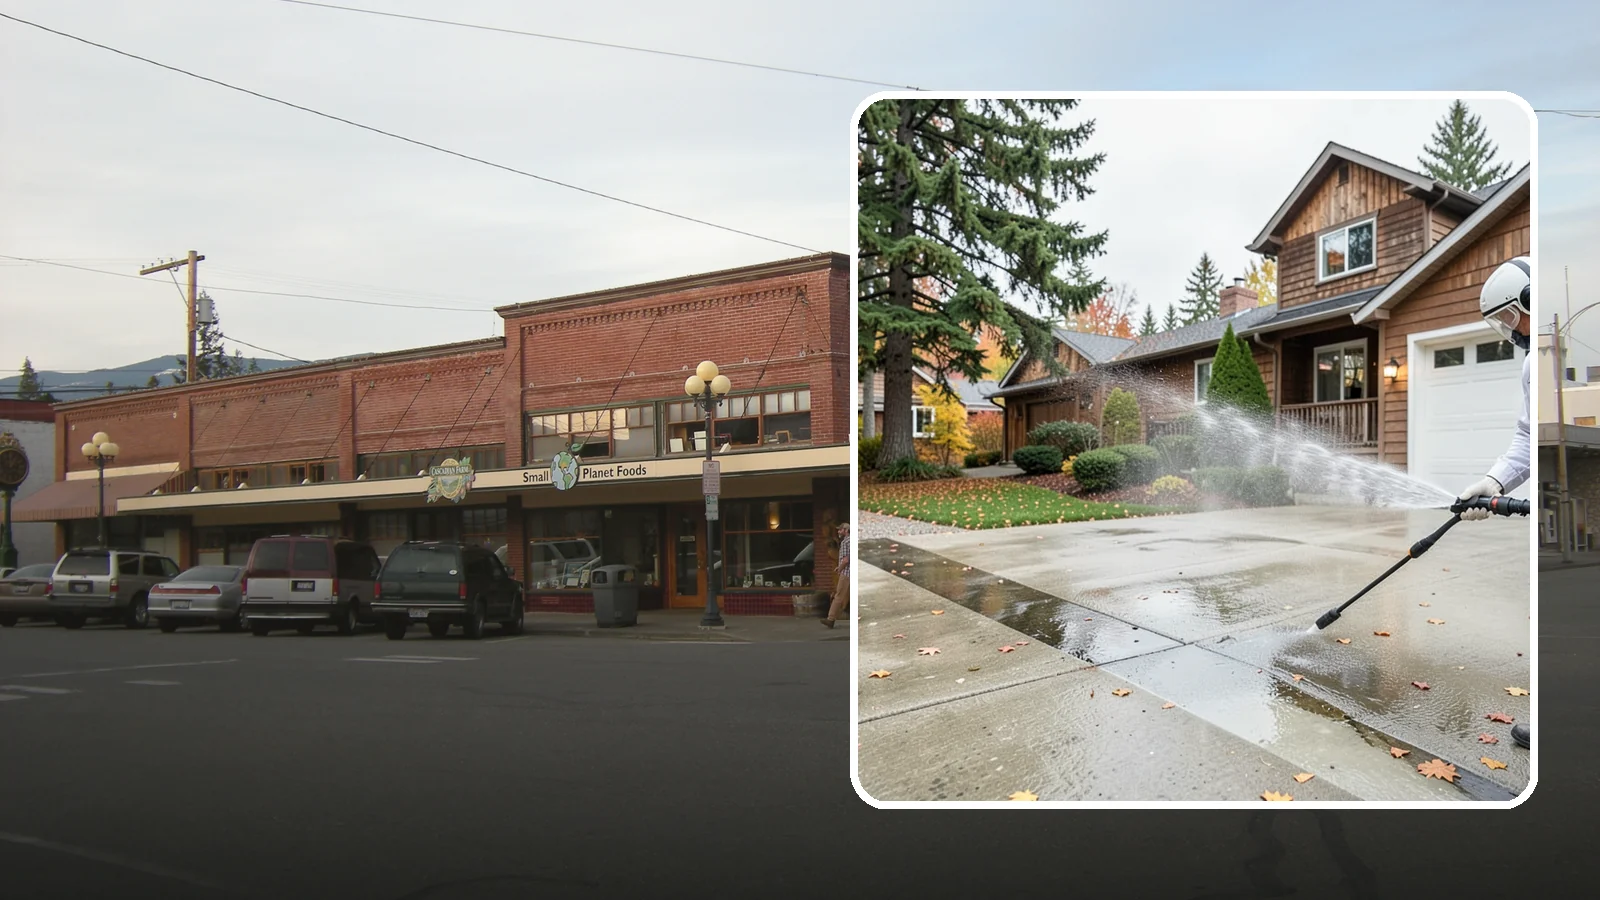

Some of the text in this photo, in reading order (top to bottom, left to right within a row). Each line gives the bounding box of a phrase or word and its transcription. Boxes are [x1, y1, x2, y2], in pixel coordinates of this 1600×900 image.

[522, 464, 647, 483] Small Planet Foods
